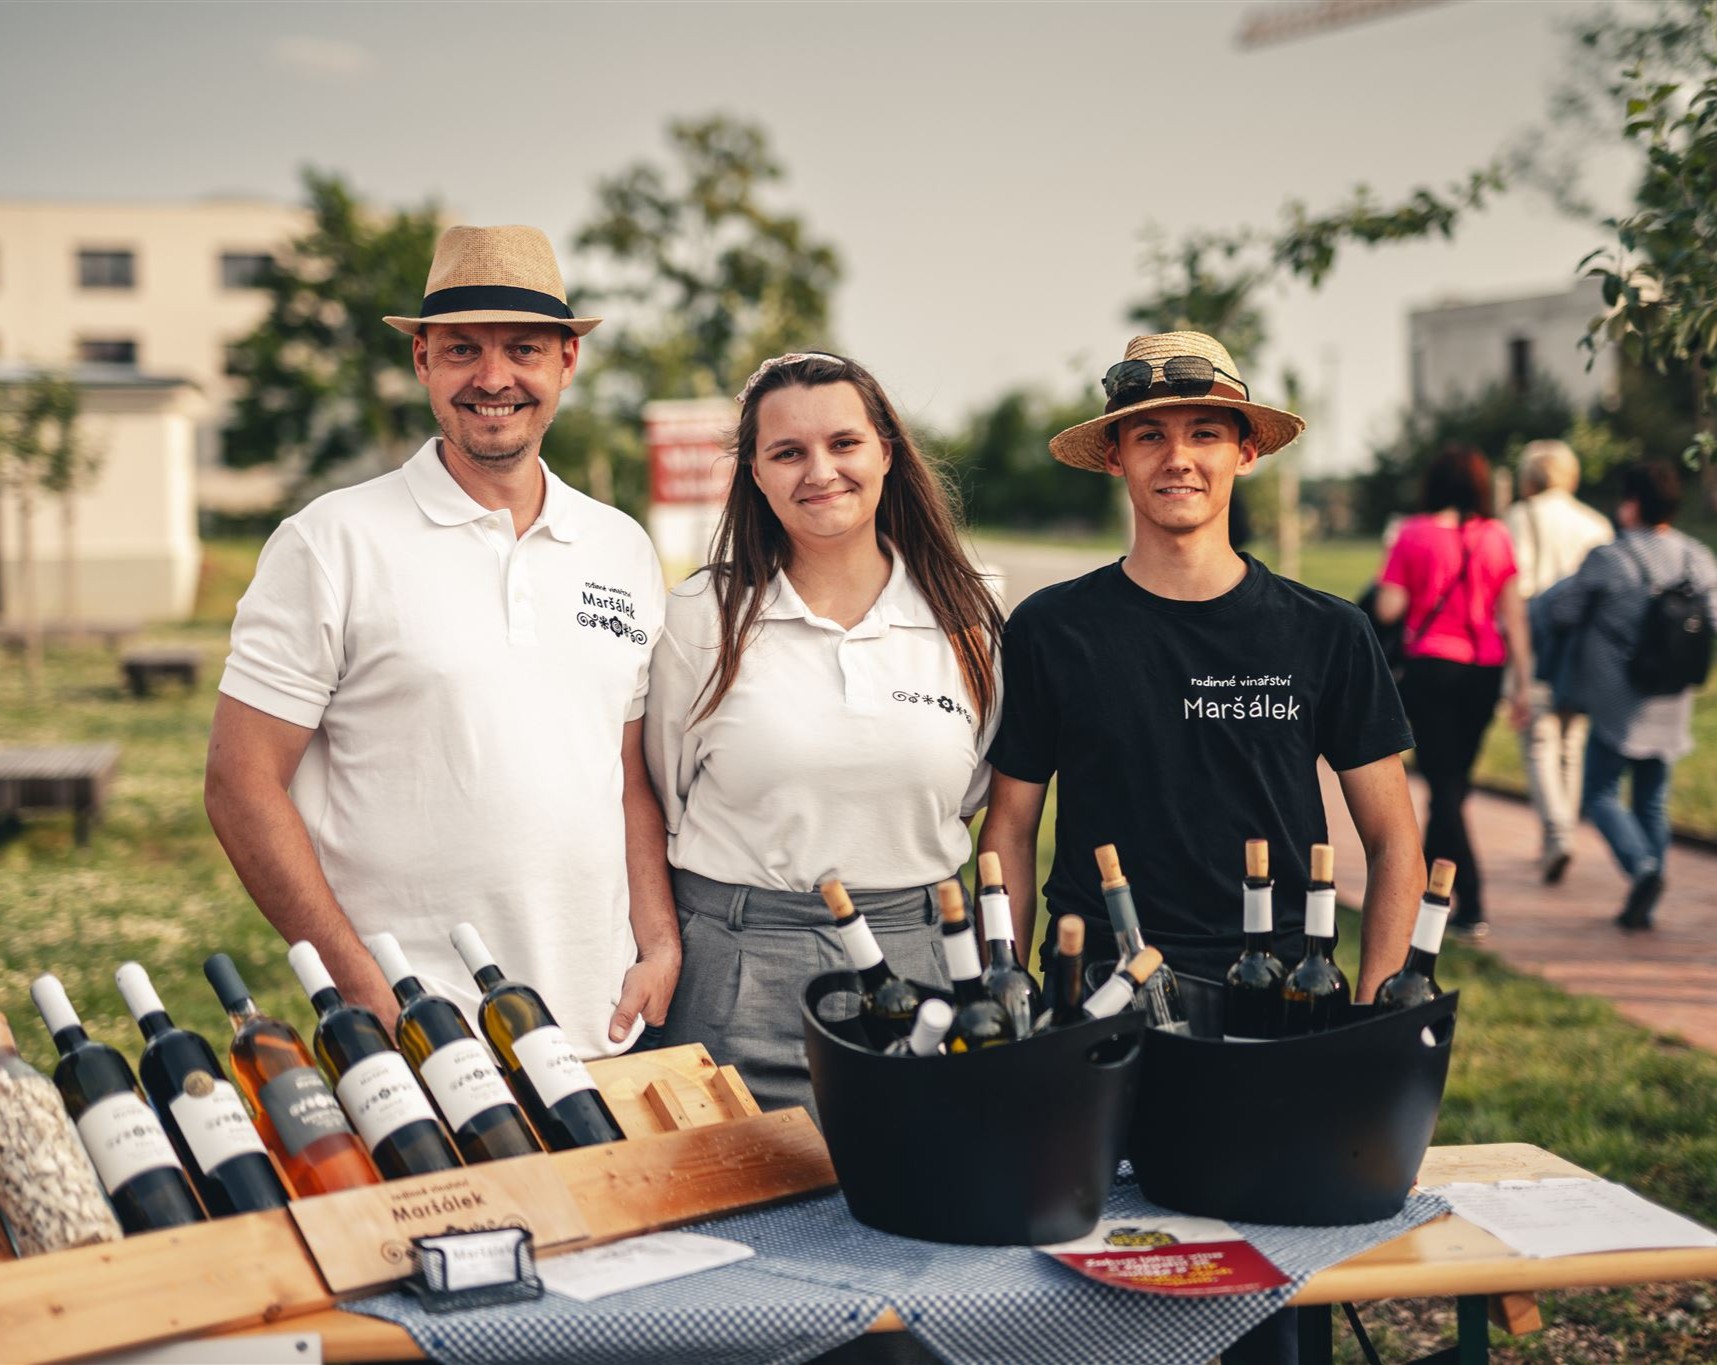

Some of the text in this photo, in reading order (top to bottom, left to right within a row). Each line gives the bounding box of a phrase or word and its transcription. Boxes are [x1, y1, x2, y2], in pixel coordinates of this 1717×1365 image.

[582, 591, 635, 620] Maršálek
[1190, 674, 1292, 687] rodinné vinařství
[1183, 693, 1300, 720] Maršálek
[391, 1190, 487, 1223] Maršálek
